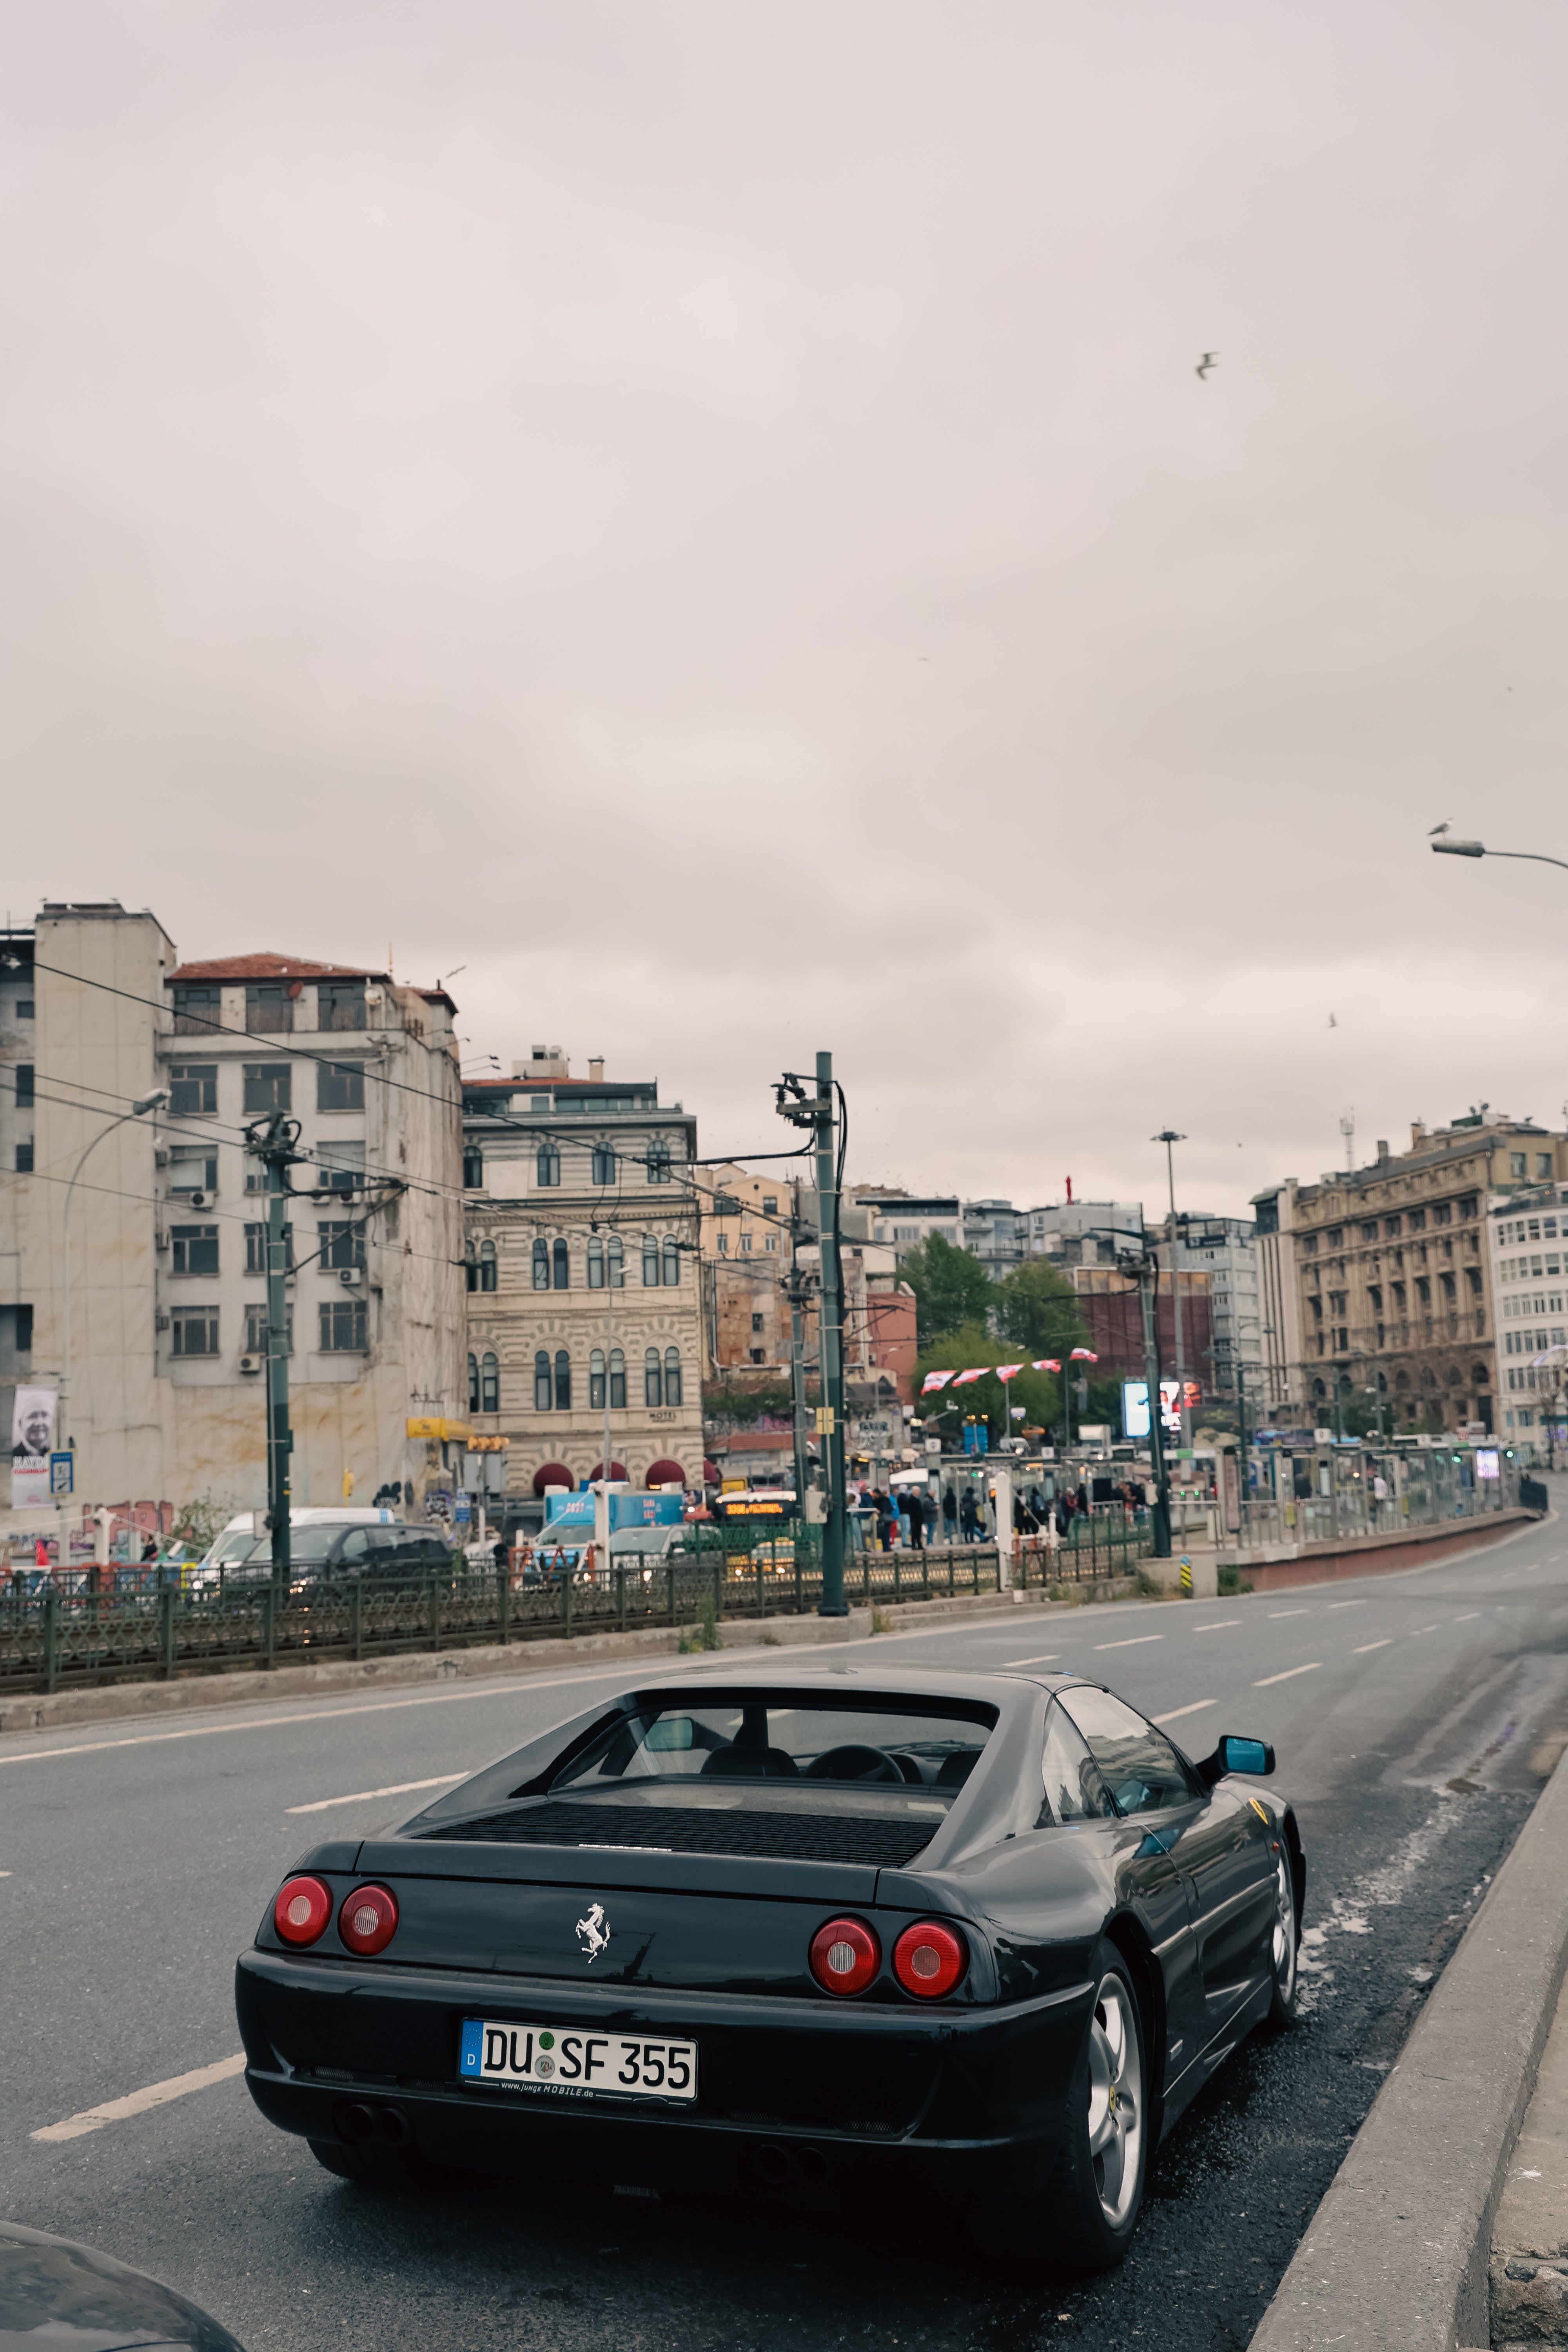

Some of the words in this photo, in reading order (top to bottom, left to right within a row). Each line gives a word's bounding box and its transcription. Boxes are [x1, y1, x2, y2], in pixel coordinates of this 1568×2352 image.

[467, 2053, 475, 2066] D
[485, 2029, 533, 2074] DU
[559, 2038, 609, 2080] SF
[618, 2042, 691, 2089] 355
